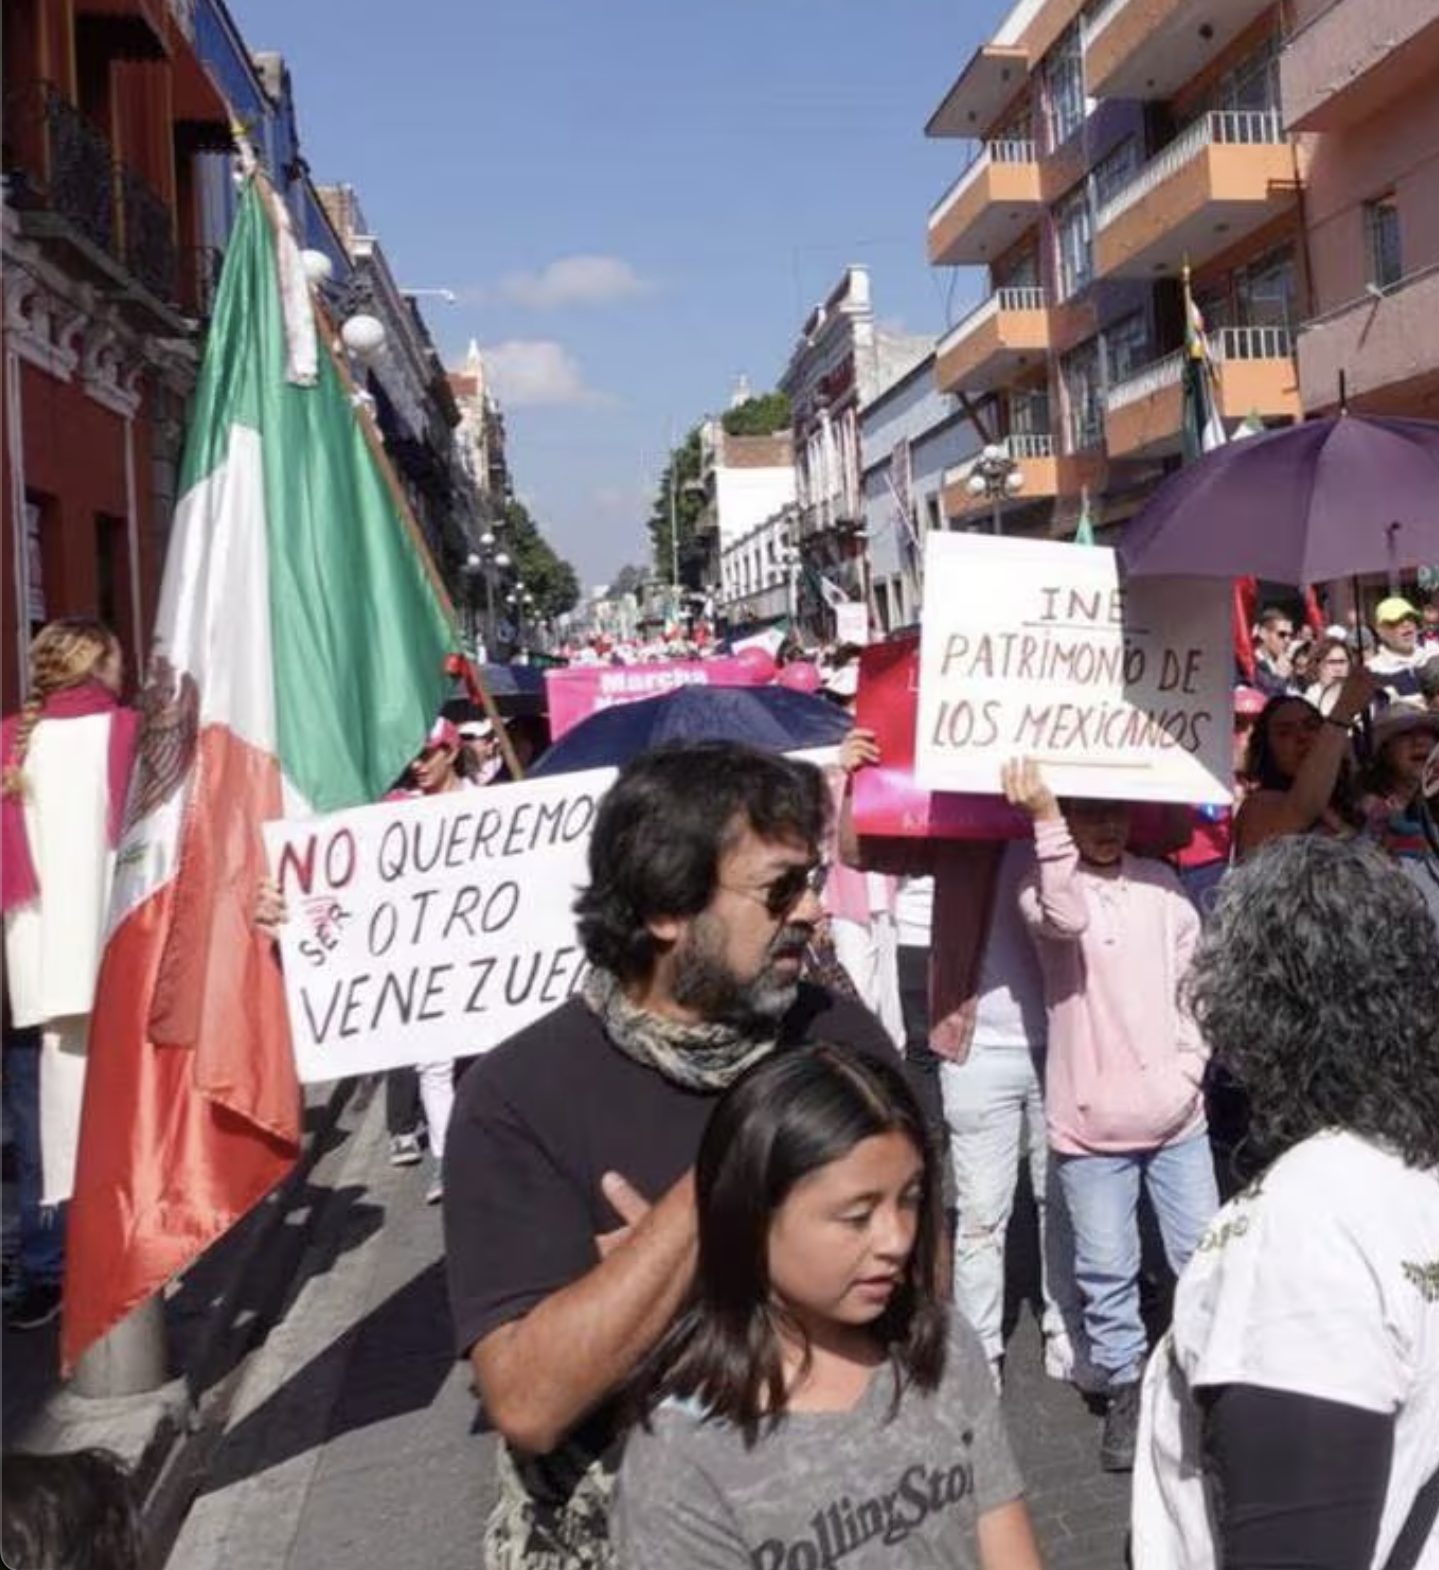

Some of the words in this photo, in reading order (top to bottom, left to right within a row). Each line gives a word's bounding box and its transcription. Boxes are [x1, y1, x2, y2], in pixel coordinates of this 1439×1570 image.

[1040, 587, 1126, 623] INE
[601, 669, 708, 693] Marcha
[1159, 648, 1203, 694] DE
[932, 700, 1002, 747] LOS
[1015, 700, 1212, 753] MEXICANOS
[278, 828, 356, 895] NO
[378, 794, 595, 882] QUEREMO
[369, 881, 519, 957] OTRO
